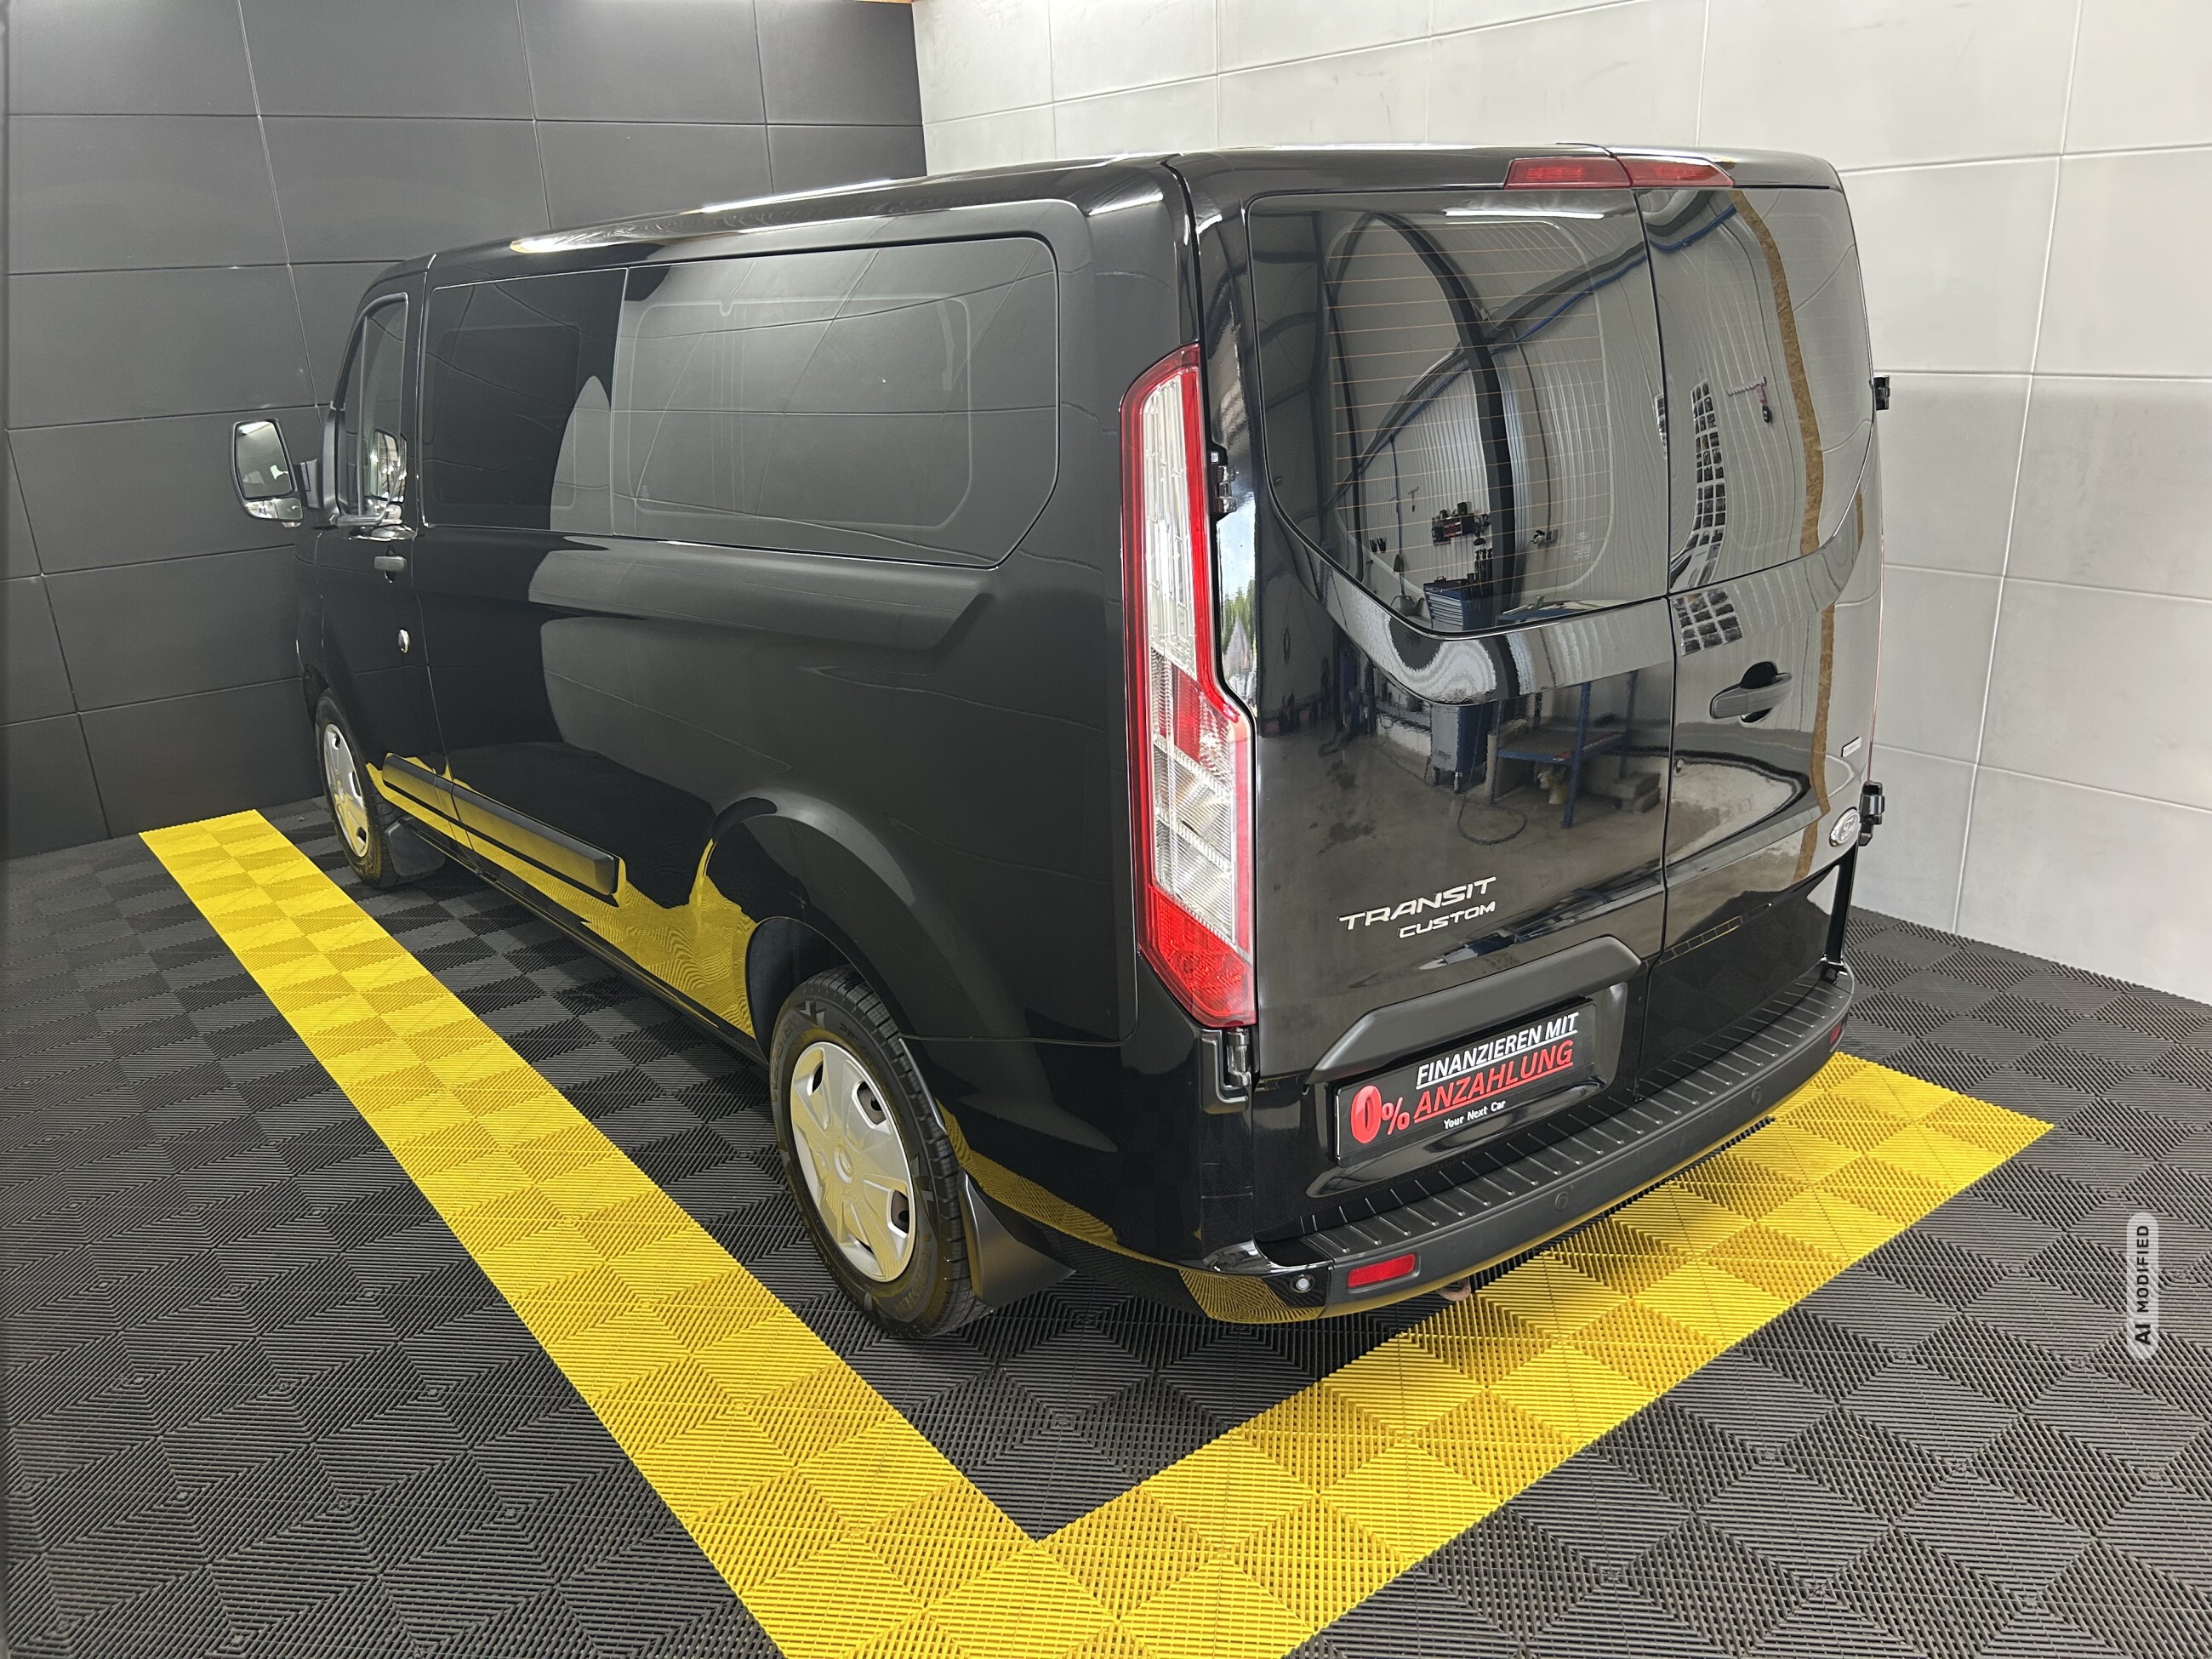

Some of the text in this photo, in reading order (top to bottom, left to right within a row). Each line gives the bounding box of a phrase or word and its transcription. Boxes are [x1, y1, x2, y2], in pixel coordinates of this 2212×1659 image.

[1338, 876, 1497, 931] TRANSIT
[1399, 901, 1497, 938] CUSTOM
[1417, 1012, 1579, 1086] FINANZIEREN MIT
[1350, 1040, 1574, 1143] 0% ANZAHLUNG
[1444, 1100, 1506, 1130] Your Next Car
